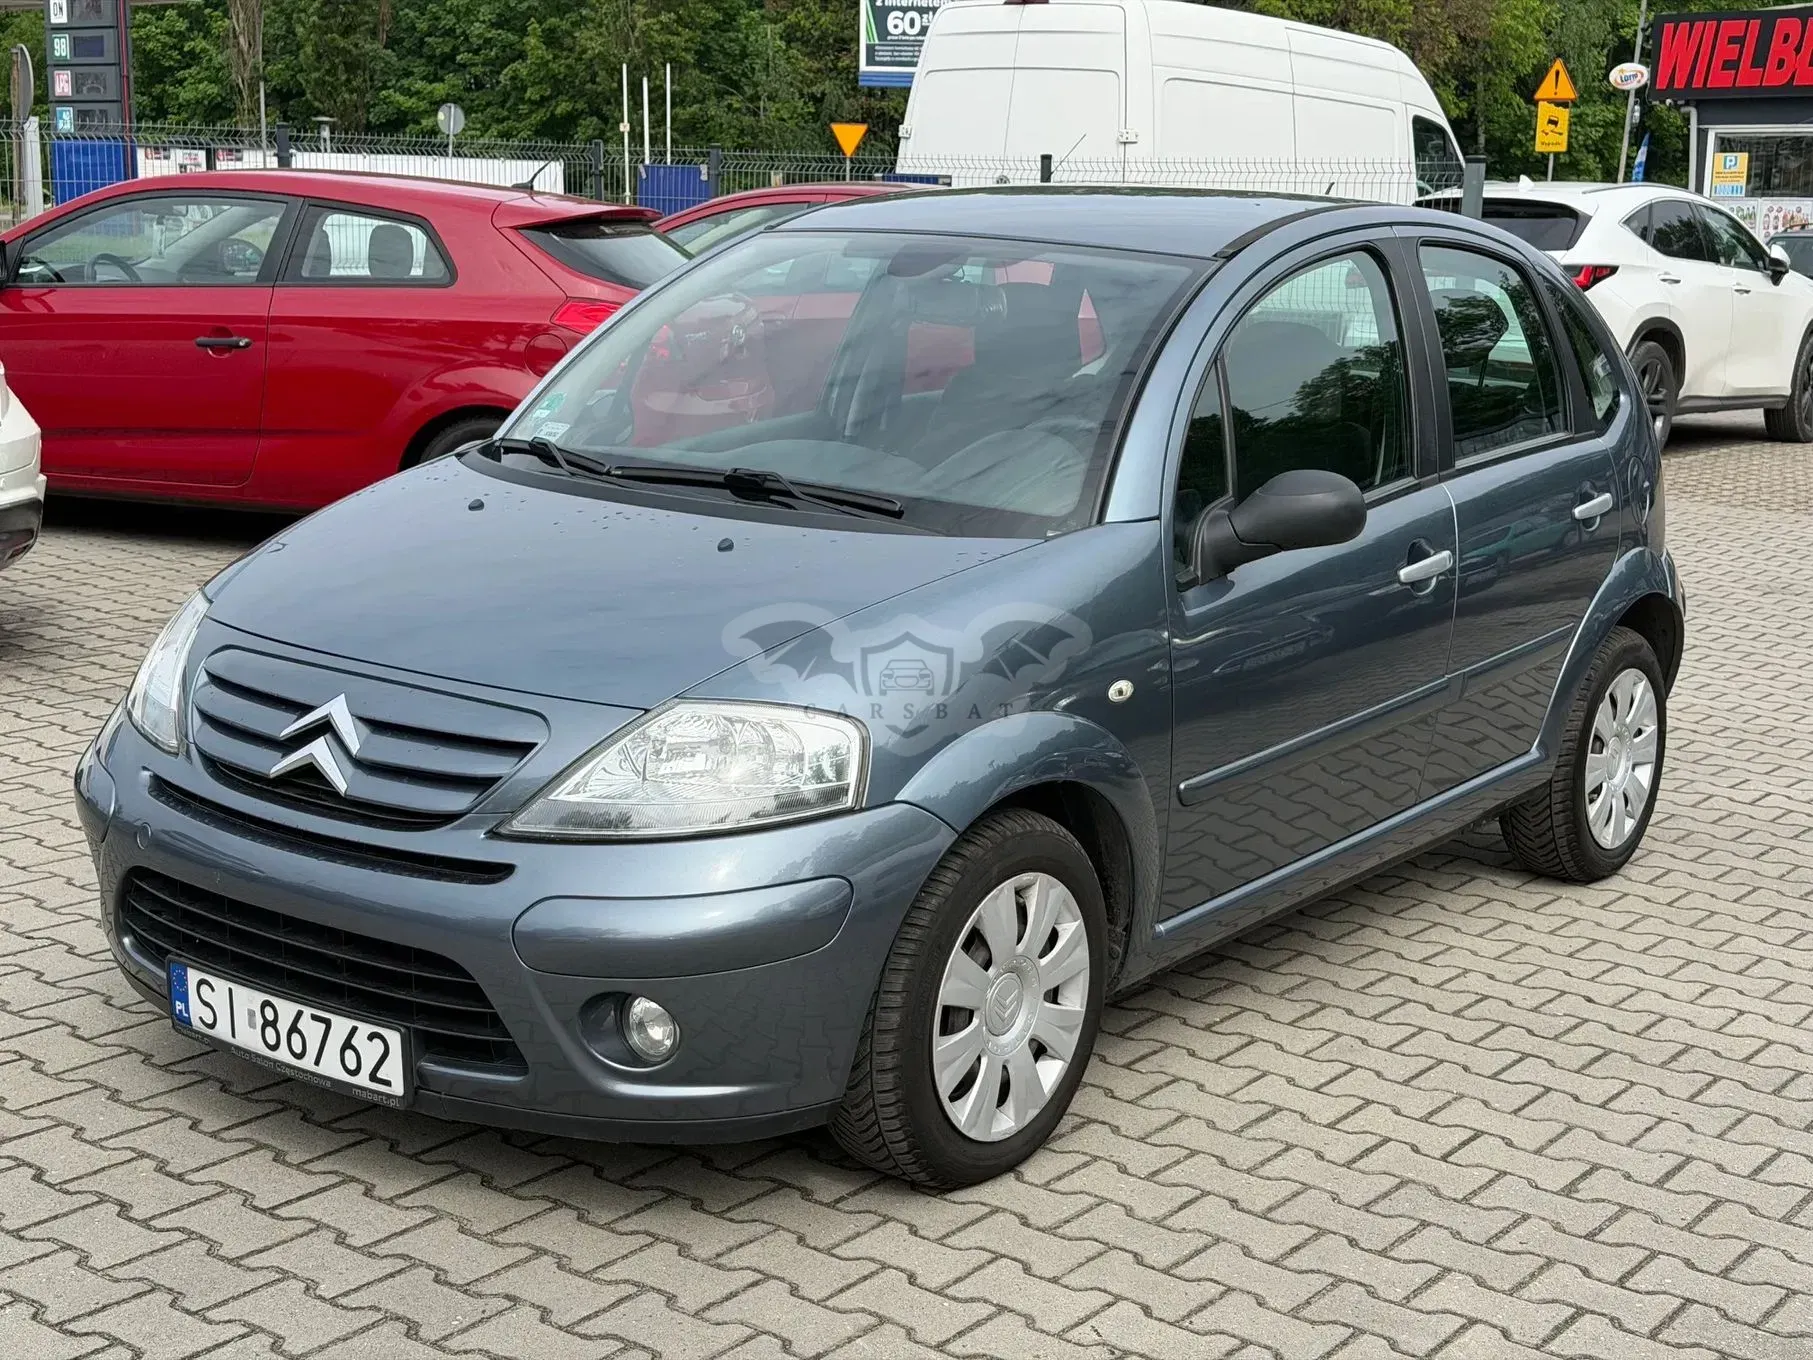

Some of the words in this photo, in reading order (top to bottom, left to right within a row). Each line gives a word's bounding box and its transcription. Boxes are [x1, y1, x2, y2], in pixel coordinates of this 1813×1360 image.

[887, 11, 921, 35] 60
[54, 38, 67, 57] 98
[175, 1001, 189, 1018] PL
[195, 977, 237, 1040] SI
[259, 999, 393, 1088] 86762
[230, 1046, 250, 1060] Auto
[251, 1053, 274, 1069] Salon
[352, 1088, 400, 1108] mabart.pl
